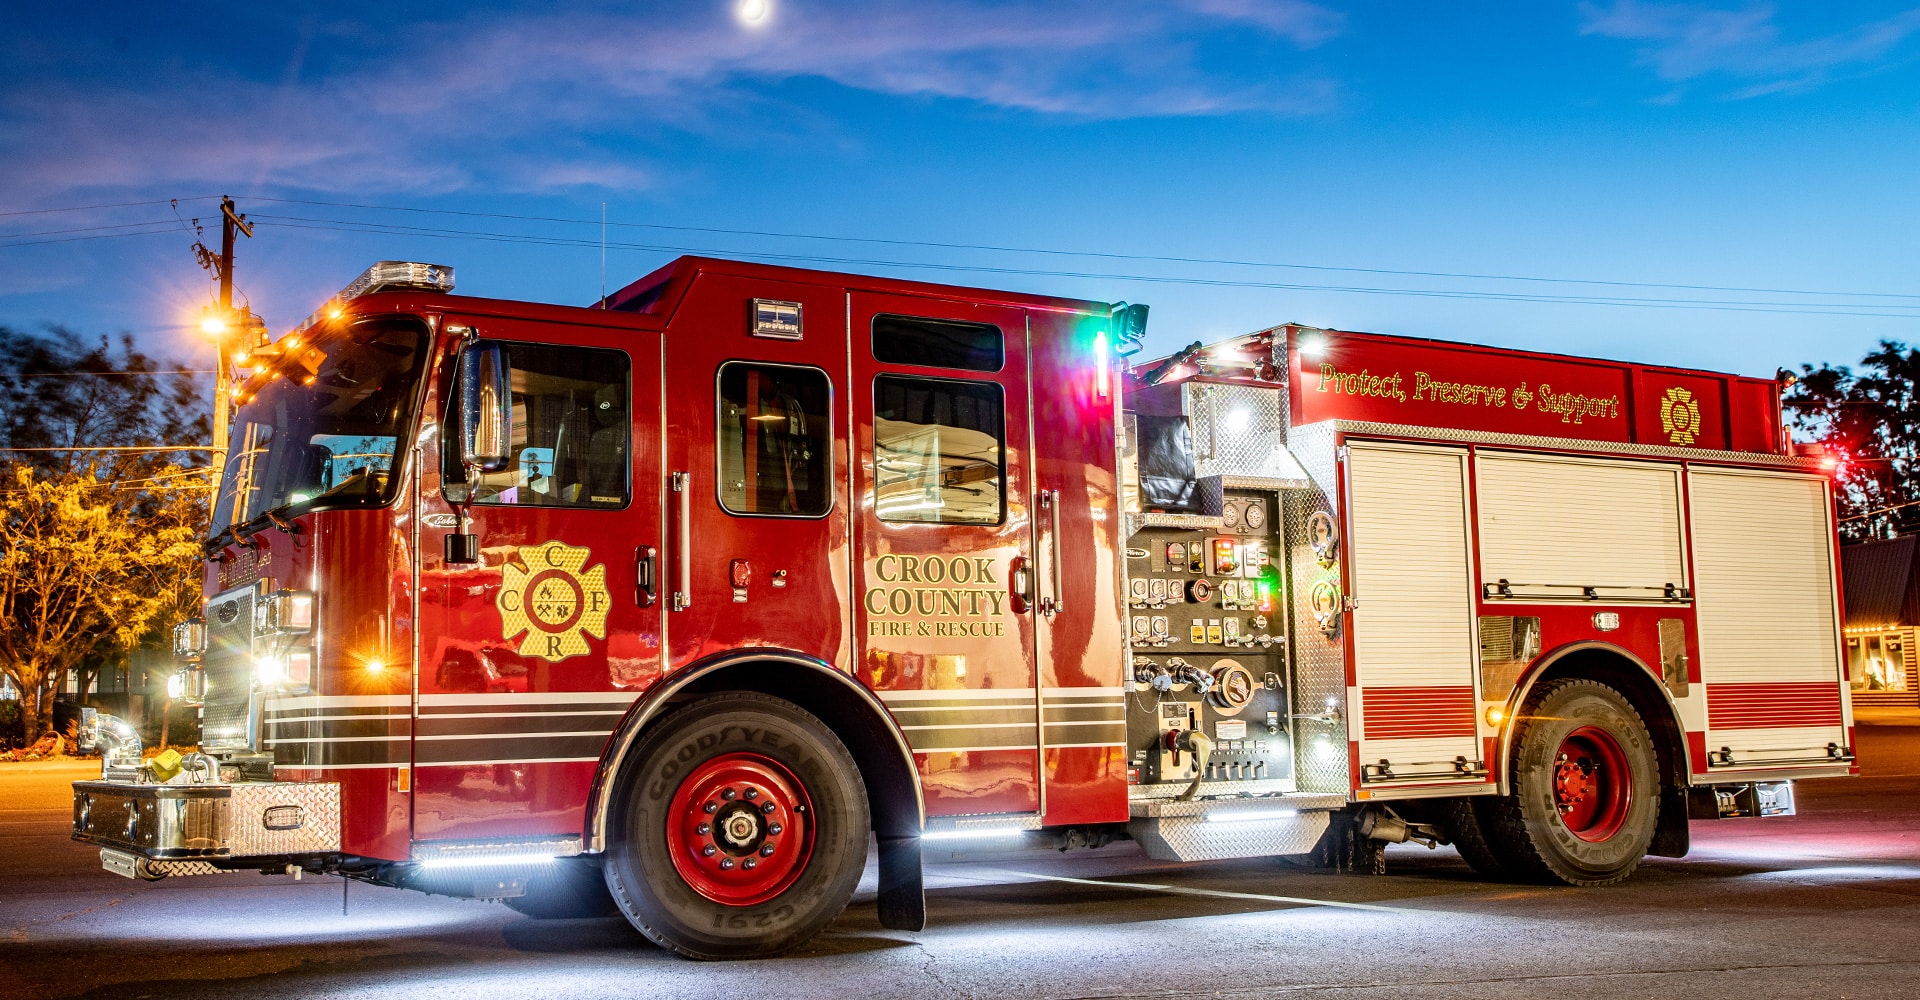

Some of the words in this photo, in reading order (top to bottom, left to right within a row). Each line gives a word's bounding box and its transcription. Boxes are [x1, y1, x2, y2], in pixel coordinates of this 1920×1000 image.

[1316, 362, 1407, 403] Protect,
[1413, 371, 1506, 408] Preserve
[1512, 382, 1533, 409] &
[1537, 384, 1619, 424] Support
[545, 545, 564, 567] C
[875, 554, 998, 584] CROOK
[500, 589, 520, 612] C
[590, 591, 605, 612] F
[864, 586, 1008, 617] COUNTY
[868, 620, 913, 637] FIRE
[916, 619, 932, 637] &
[935, 621, 1005, 638] RESCUE
[545, 635, 564, 657] R
